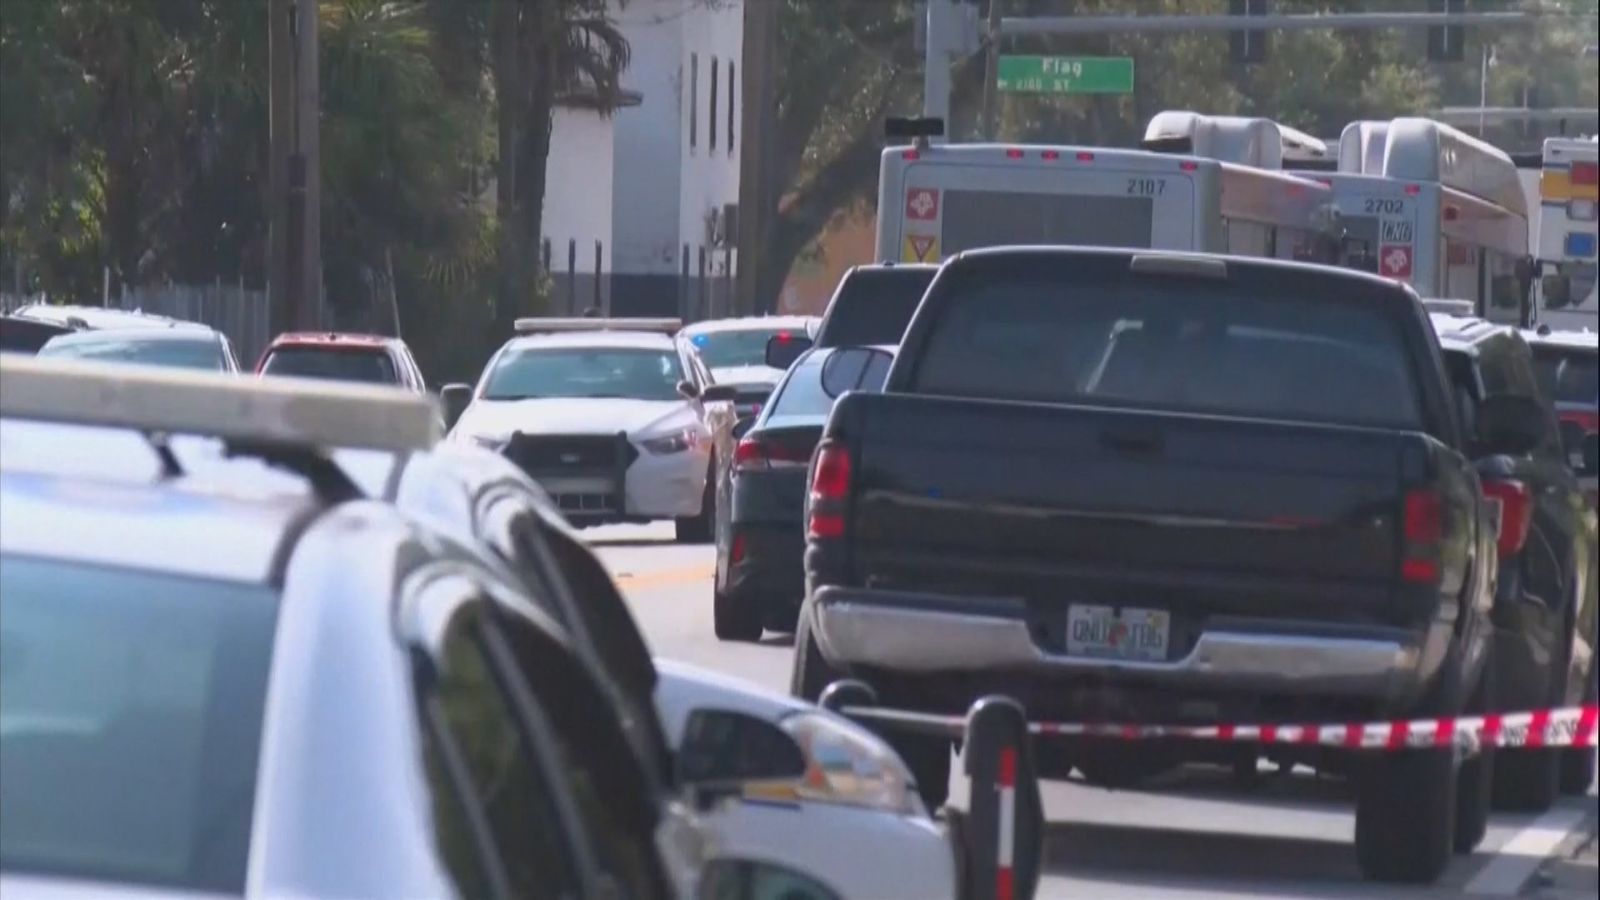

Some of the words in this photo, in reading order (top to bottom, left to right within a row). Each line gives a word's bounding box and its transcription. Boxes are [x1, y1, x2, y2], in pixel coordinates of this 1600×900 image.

[1042, 56, 1082, 78] Flag
[1126, 179, 1166, 197] 2107
[1364, 198, 1404, 214] 2702
[1382, 220, 1414, 242] CNG
